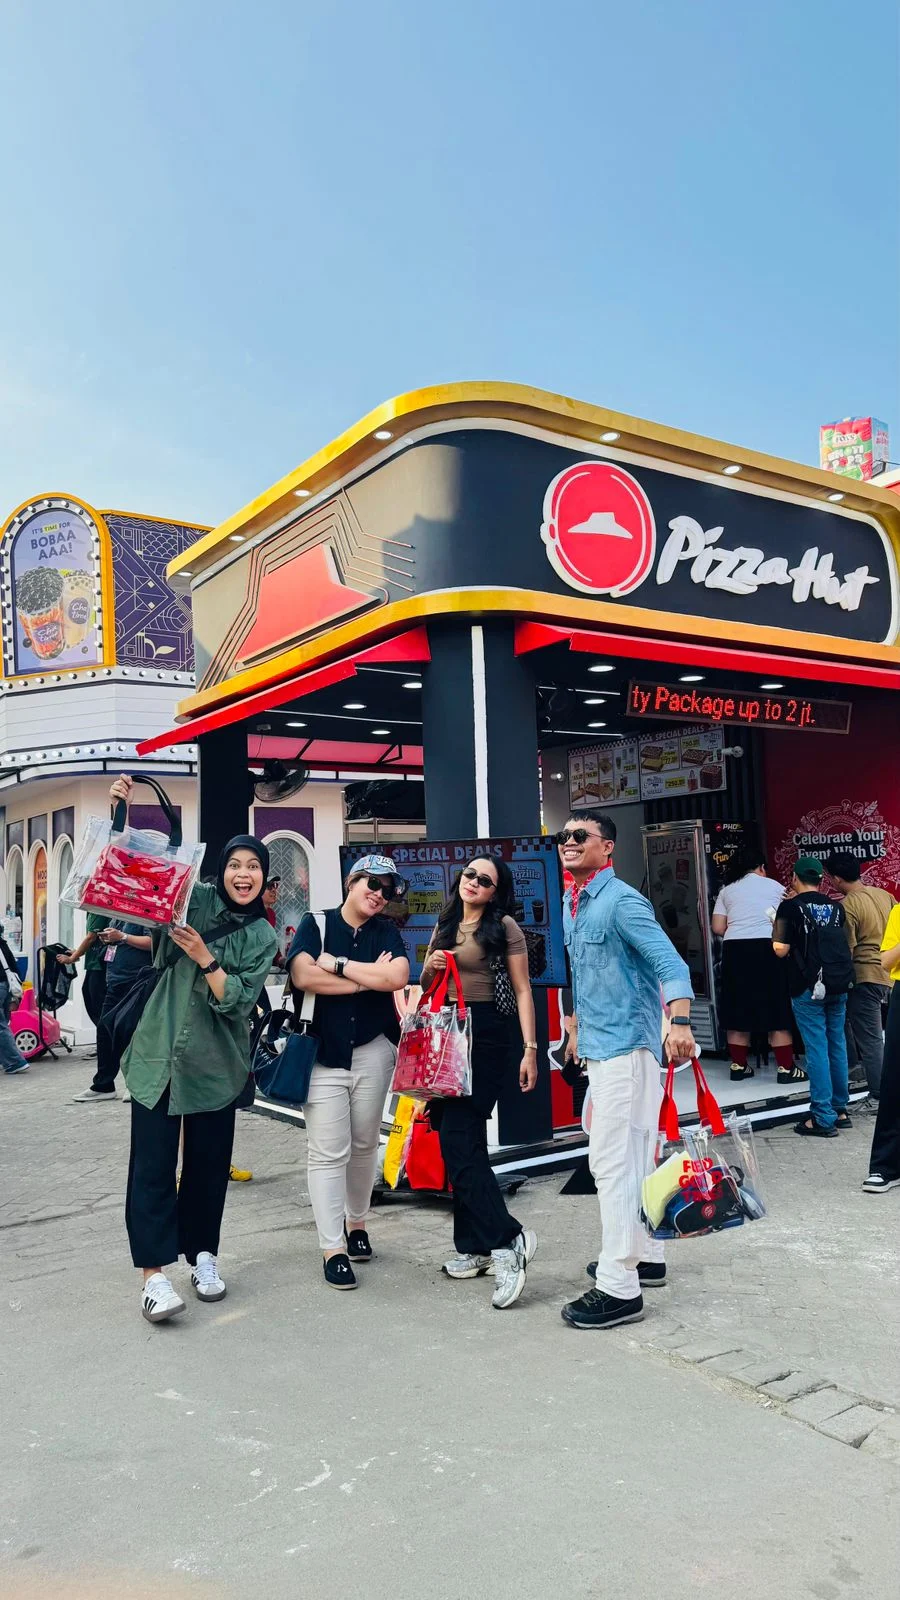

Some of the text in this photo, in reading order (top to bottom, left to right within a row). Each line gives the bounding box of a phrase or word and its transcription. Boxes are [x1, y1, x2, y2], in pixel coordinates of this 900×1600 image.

[30, 530, 76, 550] BOBAA
[38, 542, 73, 560] AAA!
[656, 515, 881, 612] Pizza Hut
[632, 685, 650, 714] ty
[655, 686, 734, 720] Package
[739, 699, 759, 722] up
[765, 699, 782, 720] to
[786, 700, 796, 722] 2
[655, 726, 704, 741] SPECIAL DEALS
[792, 829, 887, 845] Celebrate Your
[391, 844, 503, 862] SPECIAL DEALS
[797, 848, 831, 860] Event
[869, 844, 887, 857] Us
[512, 869, 541, 881] igzilla
